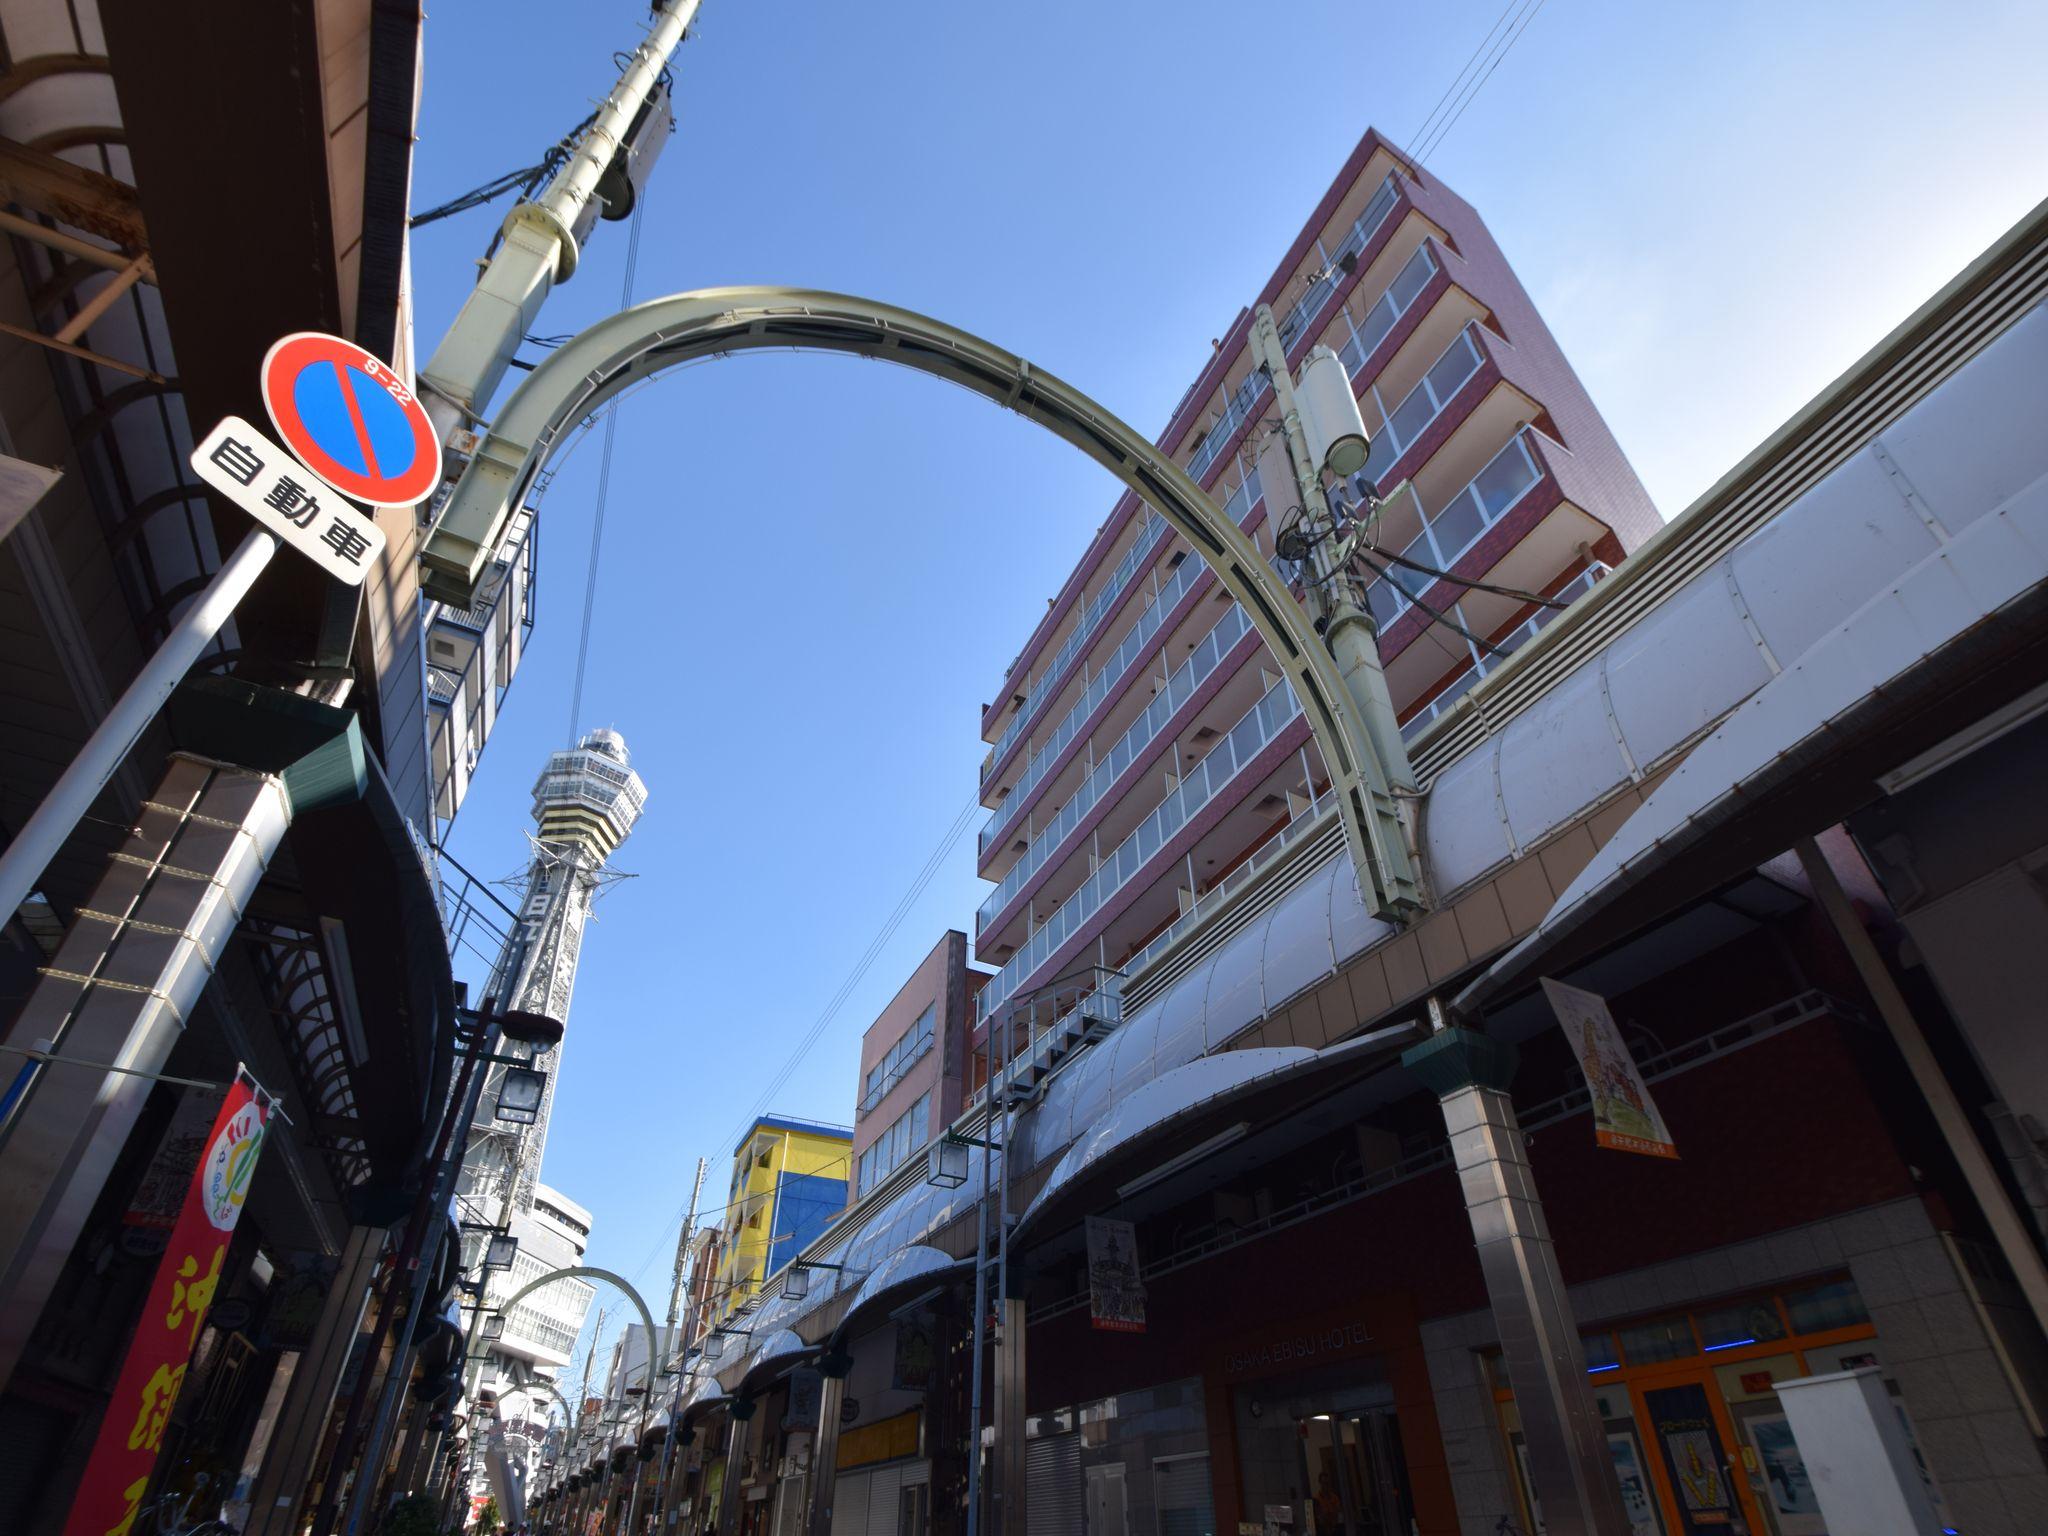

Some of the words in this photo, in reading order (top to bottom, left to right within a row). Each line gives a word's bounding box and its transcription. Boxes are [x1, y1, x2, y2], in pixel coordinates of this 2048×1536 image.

[364, 359, 412, 407] 9-22
[209, 436, 373, 567] 自動車
[1273, 1335, 1316, 1362] EBISU
[1320, 1321, 1375, 1351] HOTEL
